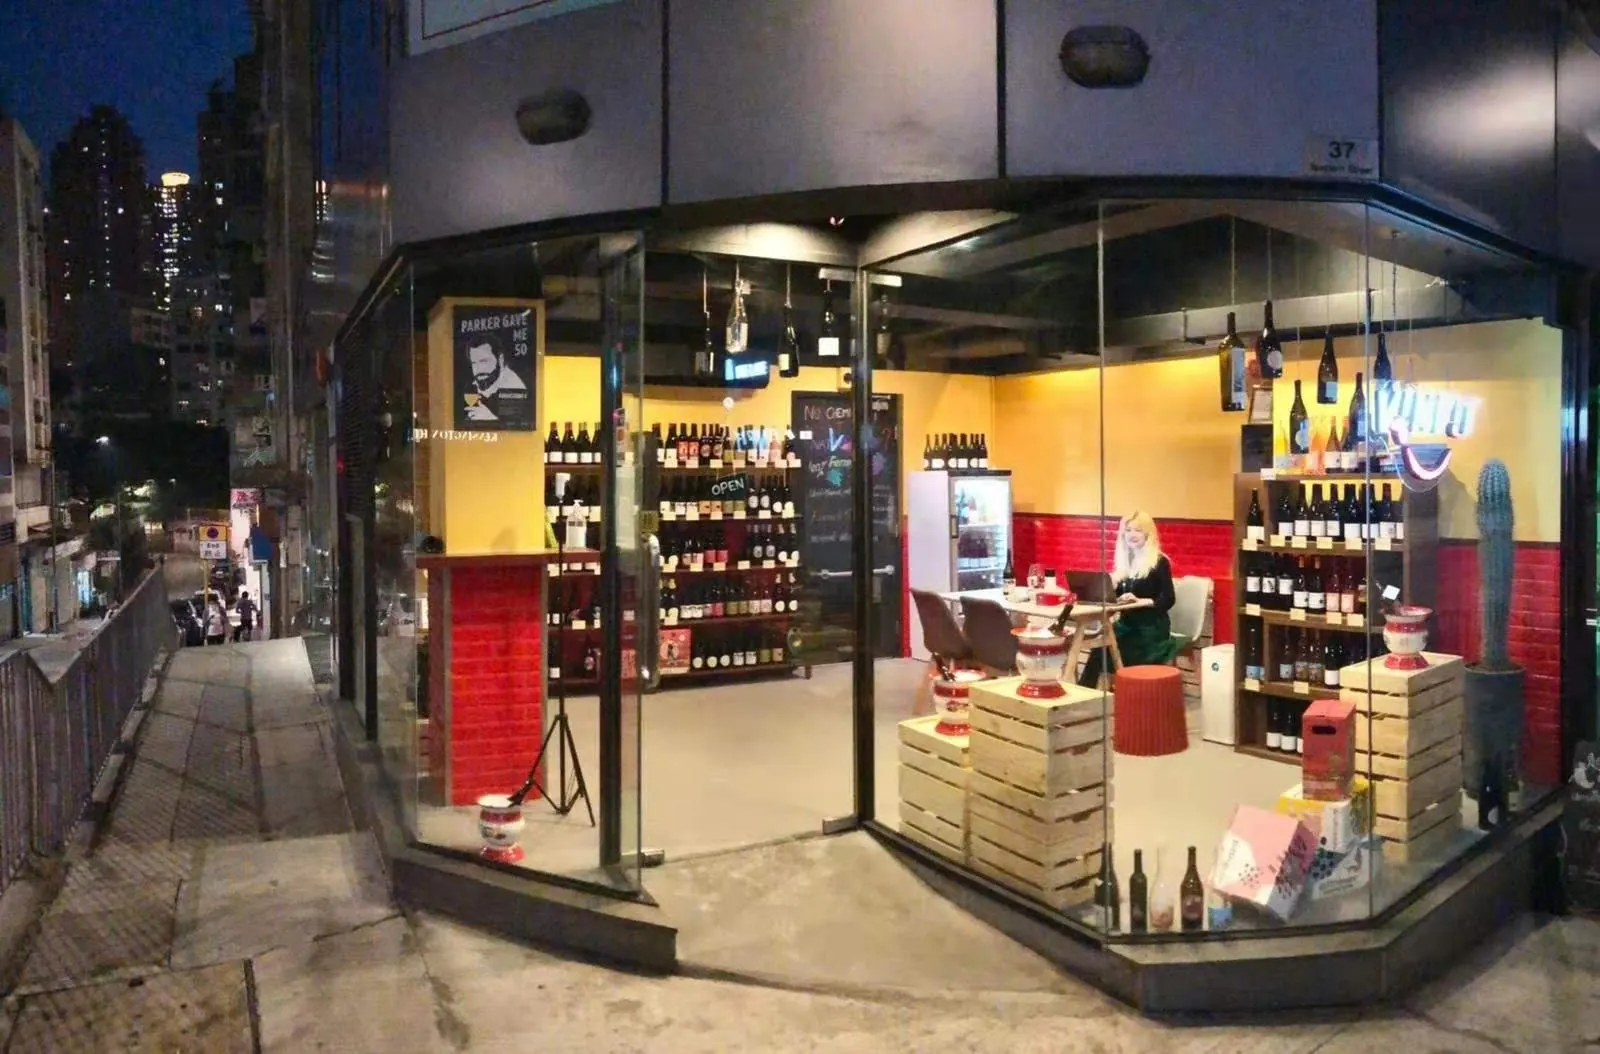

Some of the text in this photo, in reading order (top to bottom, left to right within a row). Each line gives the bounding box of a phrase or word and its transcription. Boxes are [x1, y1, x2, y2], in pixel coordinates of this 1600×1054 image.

[1328, 141, 1356, 159] 37
[461, 314, 528, 333] PARKER GAVE
[513, 328, 528, 341] ME
[711, 477, 745, 496] OPEN
